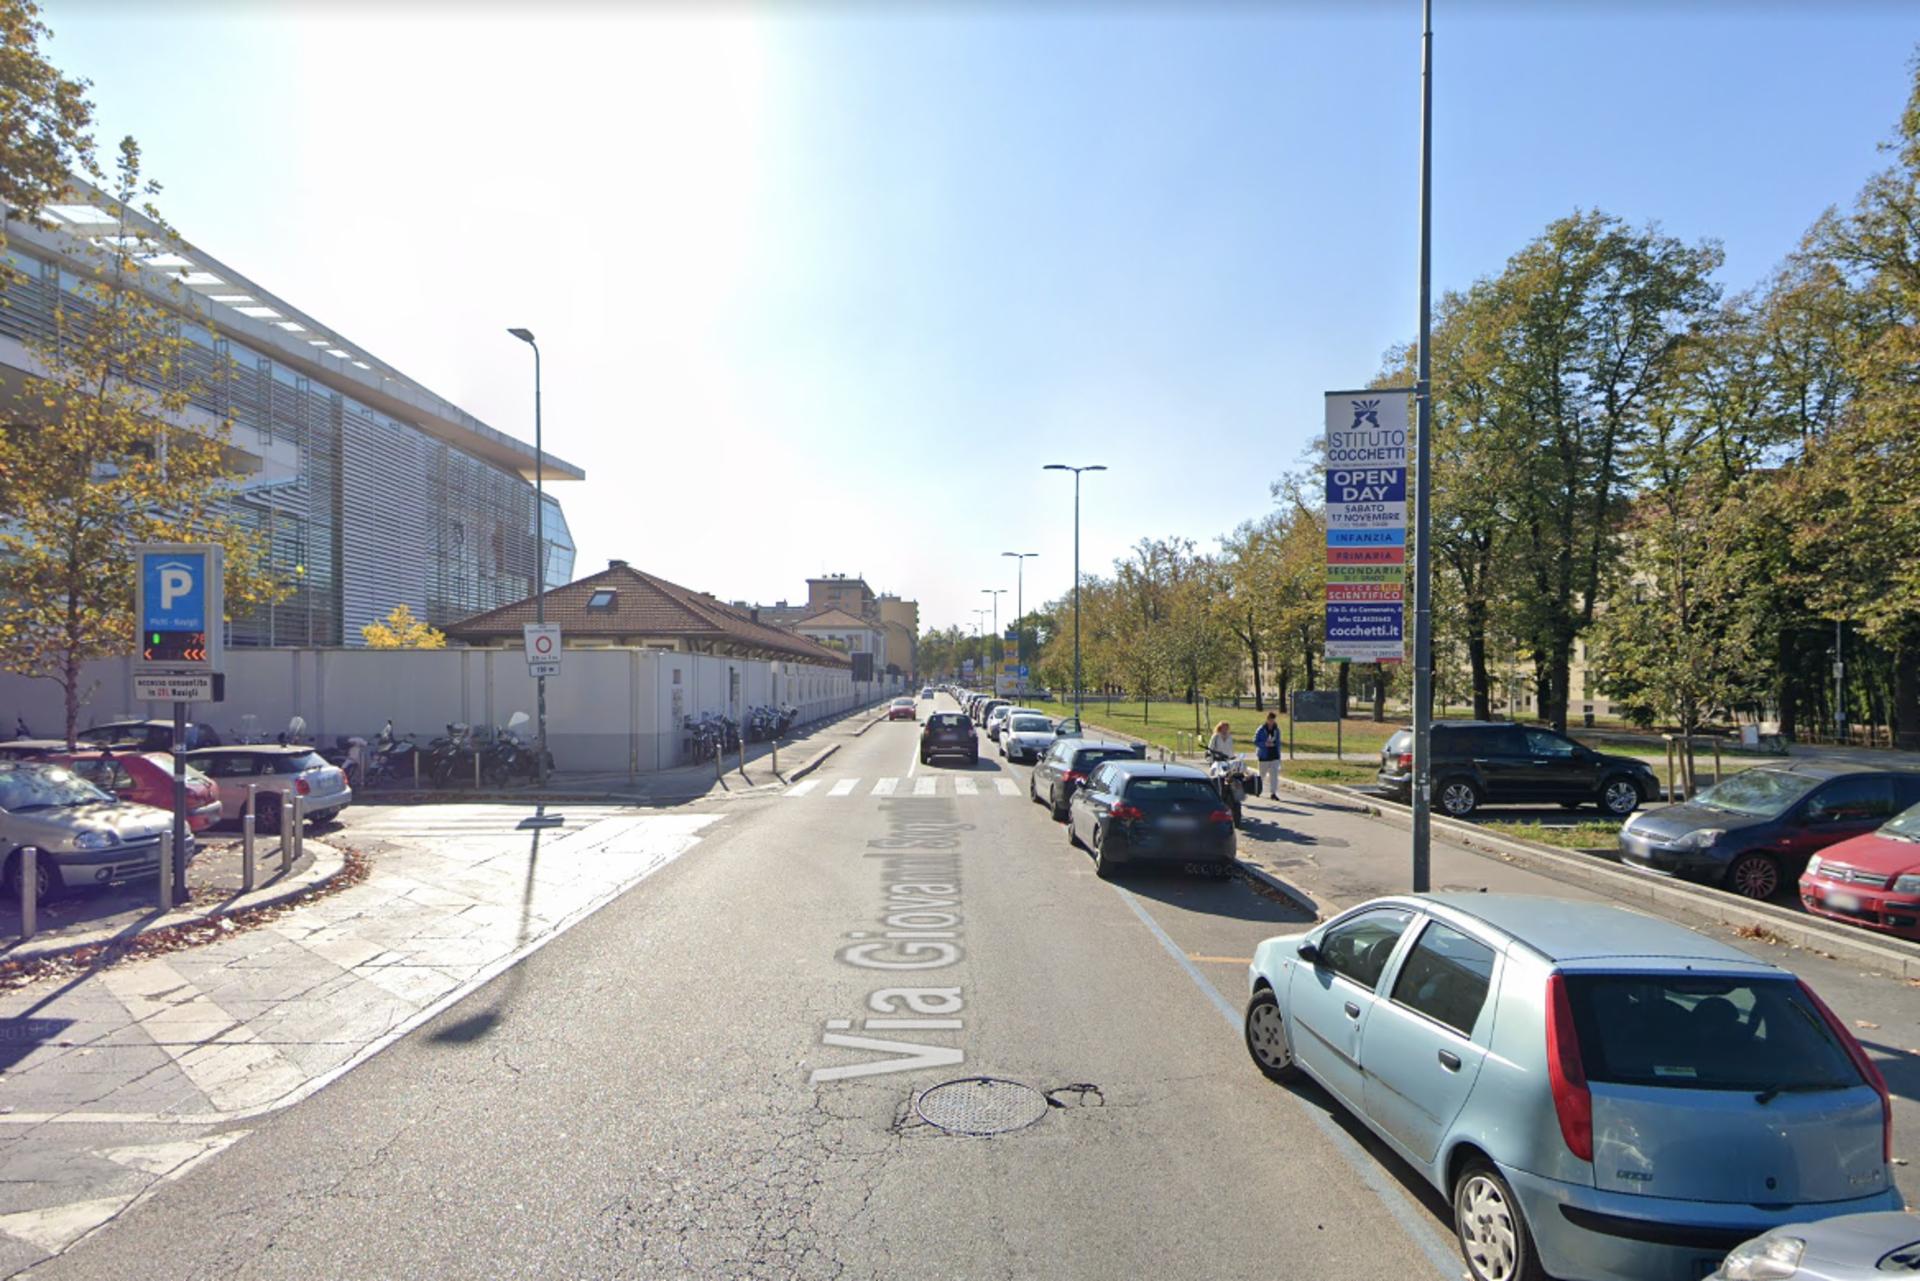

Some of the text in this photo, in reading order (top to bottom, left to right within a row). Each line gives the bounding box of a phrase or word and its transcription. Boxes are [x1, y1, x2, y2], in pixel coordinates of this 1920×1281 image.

[1327, 430, 1405, 448] ISTITUTO
[1328, 447, 1405, 461] COCCHETTI
[1334, 470, 1398, 486] OPEN
[1342, 486, 1389, 502] DAY
[1345, 504, 1385, 513] SABATO
[1332, 512, 1401, 522] 17 NOVEMBRE
[1336, 533, 1393, 543] INFANZIA
[1336, 551, 1393, 561] PRIMARIA
[1328, 566, 1402, 575] SECONDARIA
[160, 568, 193, 610] P
[1328, 591, 1400, 600] SCIENTIFICO
[1330, 625, 1399, 637] cocchetti.it
